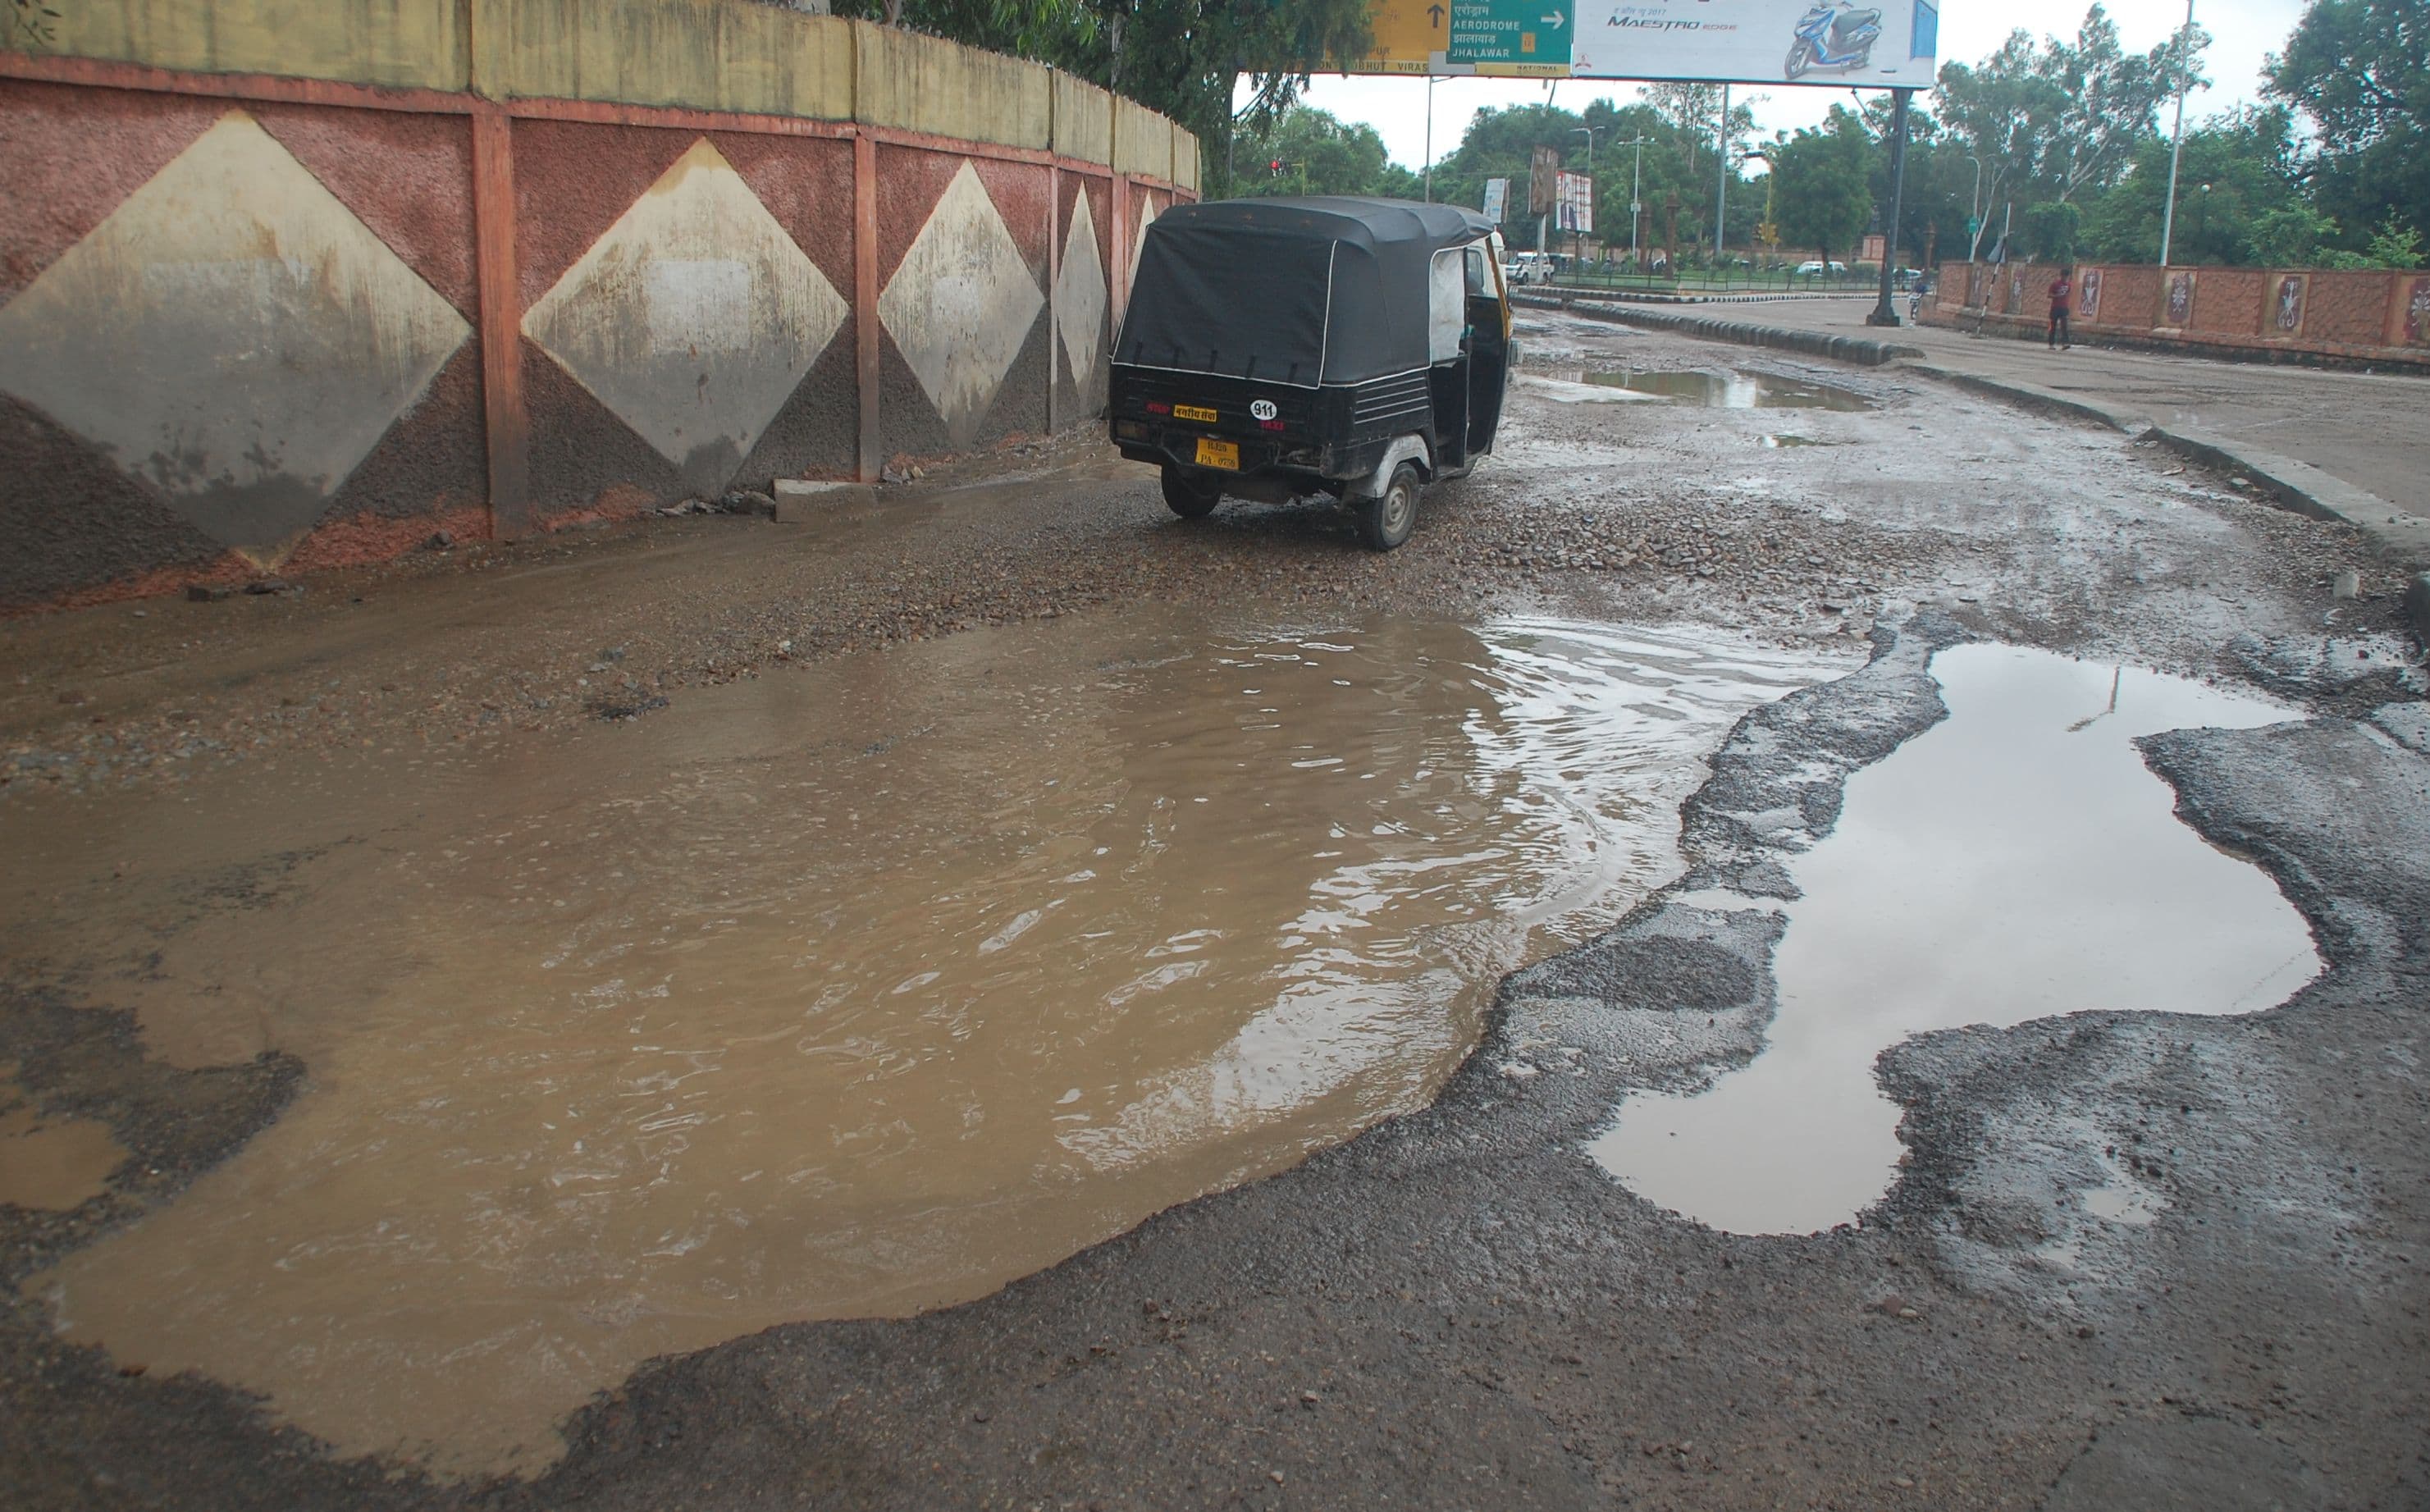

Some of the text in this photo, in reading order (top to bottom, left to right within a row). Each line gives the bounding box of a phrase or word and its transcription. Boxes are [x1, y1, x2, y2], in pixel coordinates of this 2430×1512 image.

[1453, 21, 1520, 31] AERODROME
[1606, 16, 1701, 33] MAESTRO
[1453, 48, 1510, 58] JHALAWAR
[1254, 403, 1273, 417] 911
